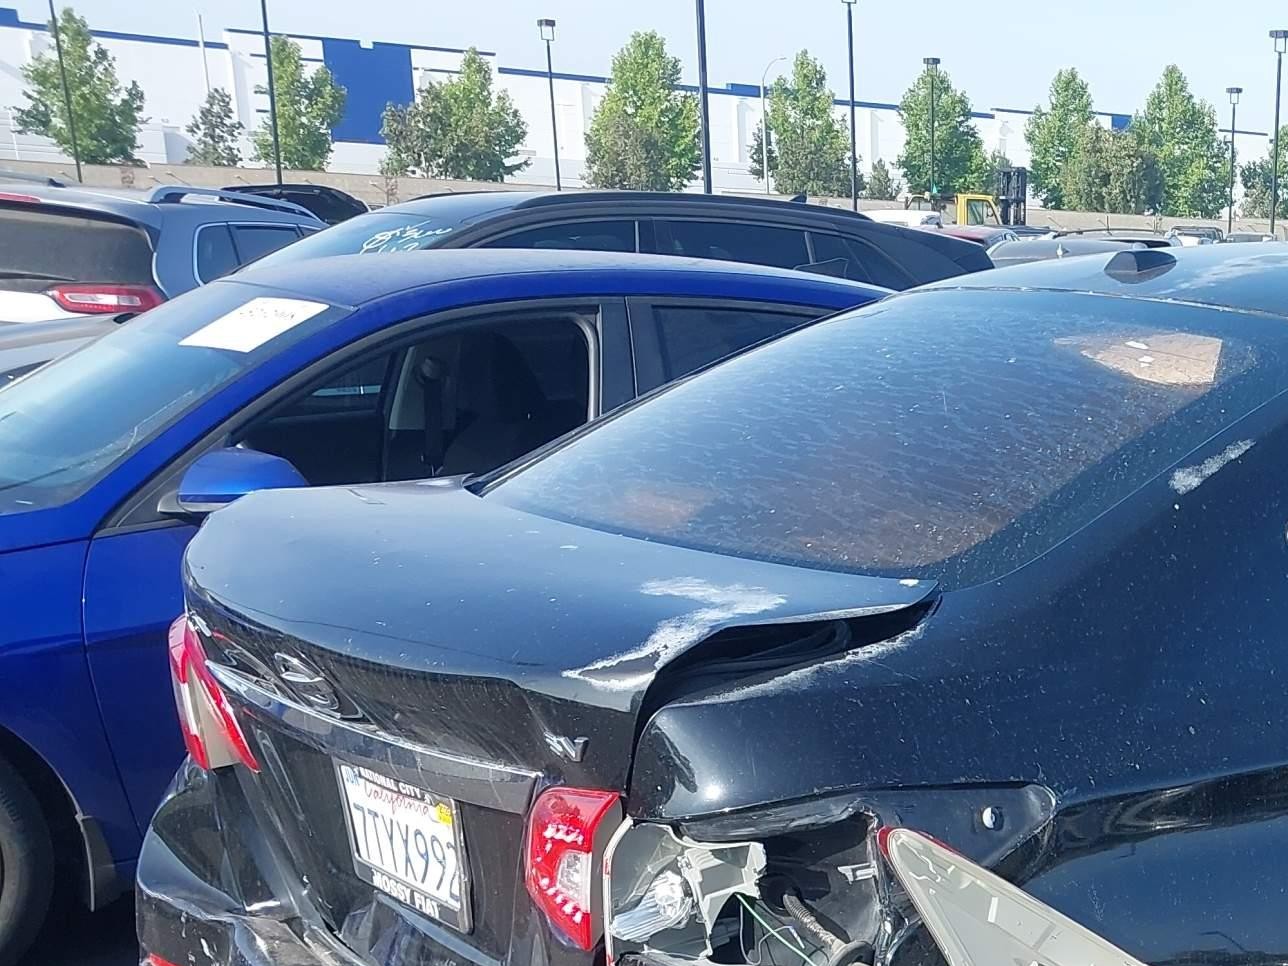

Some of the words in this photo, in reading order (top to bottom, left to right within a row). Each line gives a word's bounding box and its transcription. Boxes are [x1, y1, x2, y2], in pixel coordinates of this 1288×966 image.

[398, 780, 421, 799] CITY
[371, 867, 412, 905] MOSSY
[413, 889, 440, 919] FIAT
